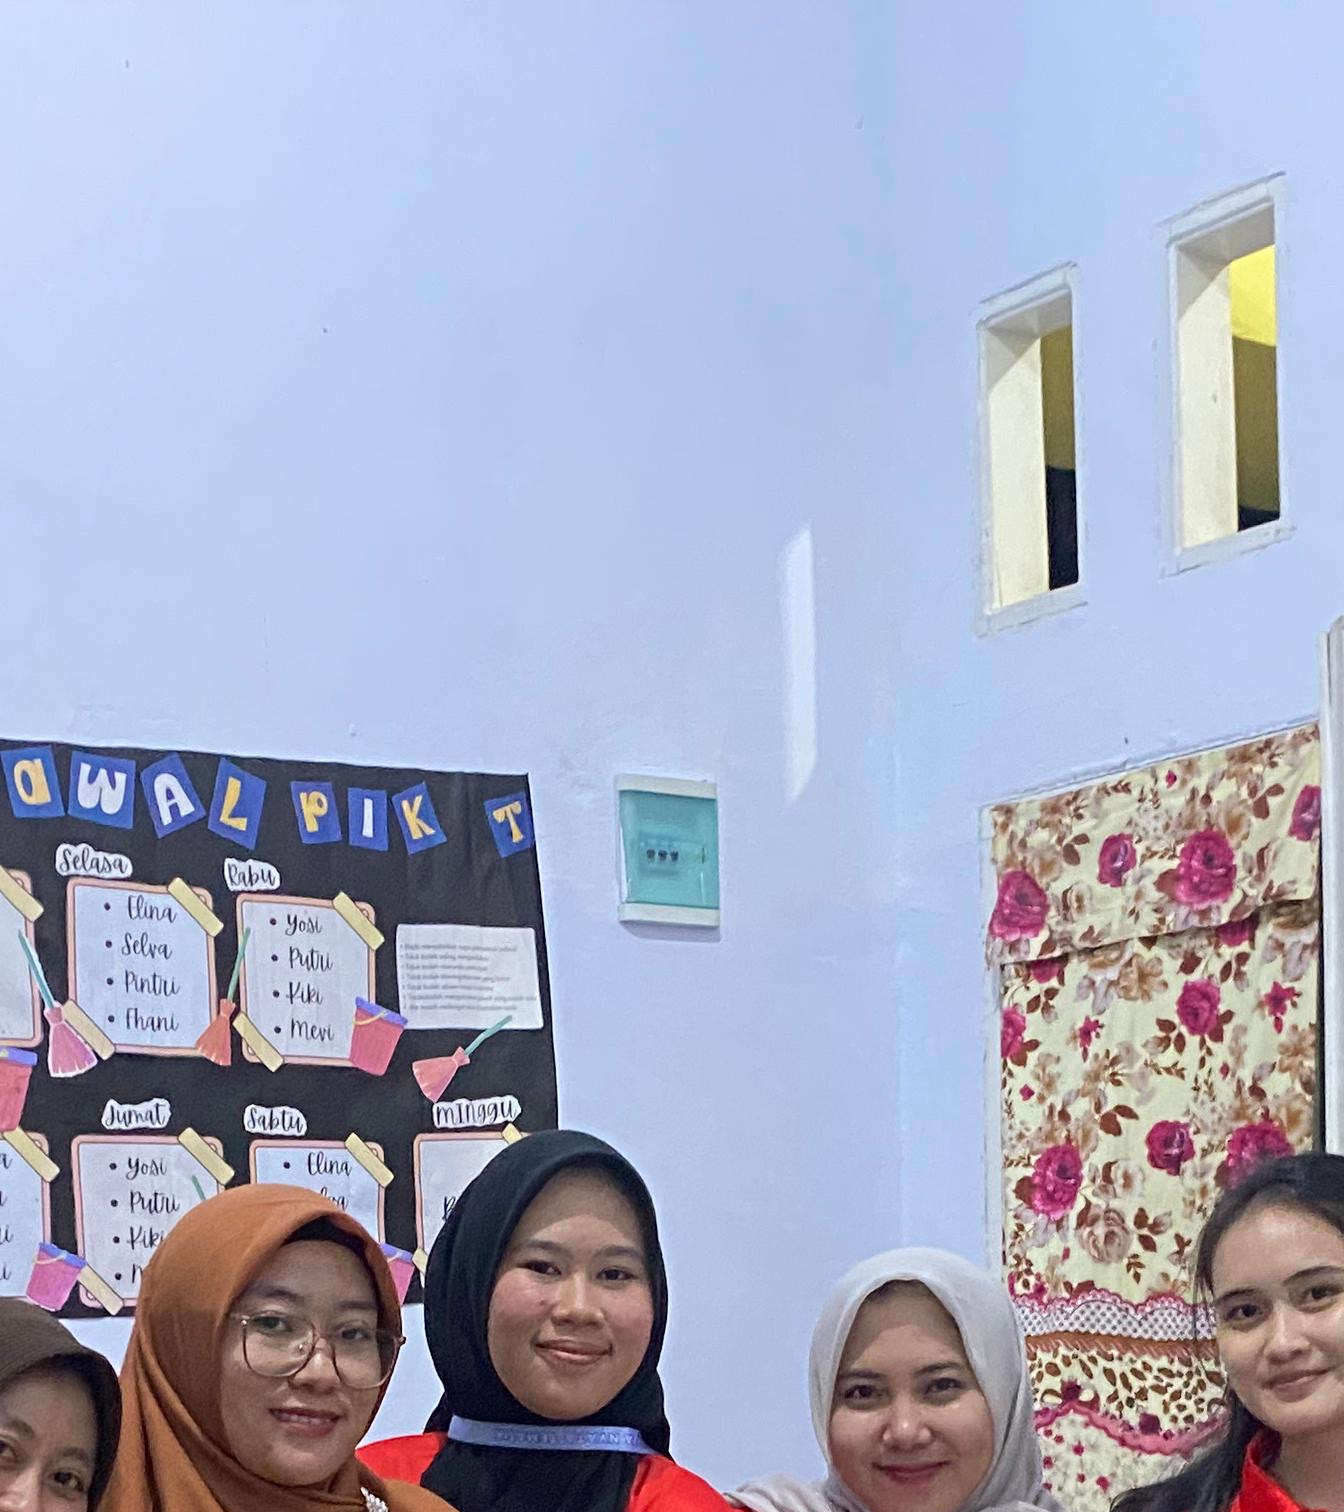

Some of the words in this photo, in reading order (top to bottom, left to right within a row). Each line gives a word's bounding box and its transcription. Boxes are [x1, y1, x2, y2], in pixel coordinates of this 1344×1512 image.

[59, 849, 128, 873] Selasa
[227, 863, 276, 887] Rabu
[127, 895, 177, 923] Elina
[285, 914, 323, 936] Yosi
[121, 932, 172, 960] Selva
[288, 946, 333, 972] Putri
[125, 970, 180, 997] Pintri
[286, 982, 323, 1005] Kiki
[126, 1008, 180, 1031] Fhani
[290, 1018, 335, 1041] Mevi
[105, 1103, 166, 1127] Jumat
[246, 1108, 304, 1132] Sabtu
[125, 1157, 167, 1180] Yosi
[307, 1151, 351, 1177] Elina
[130, 1190, 180, 1215] Putri
